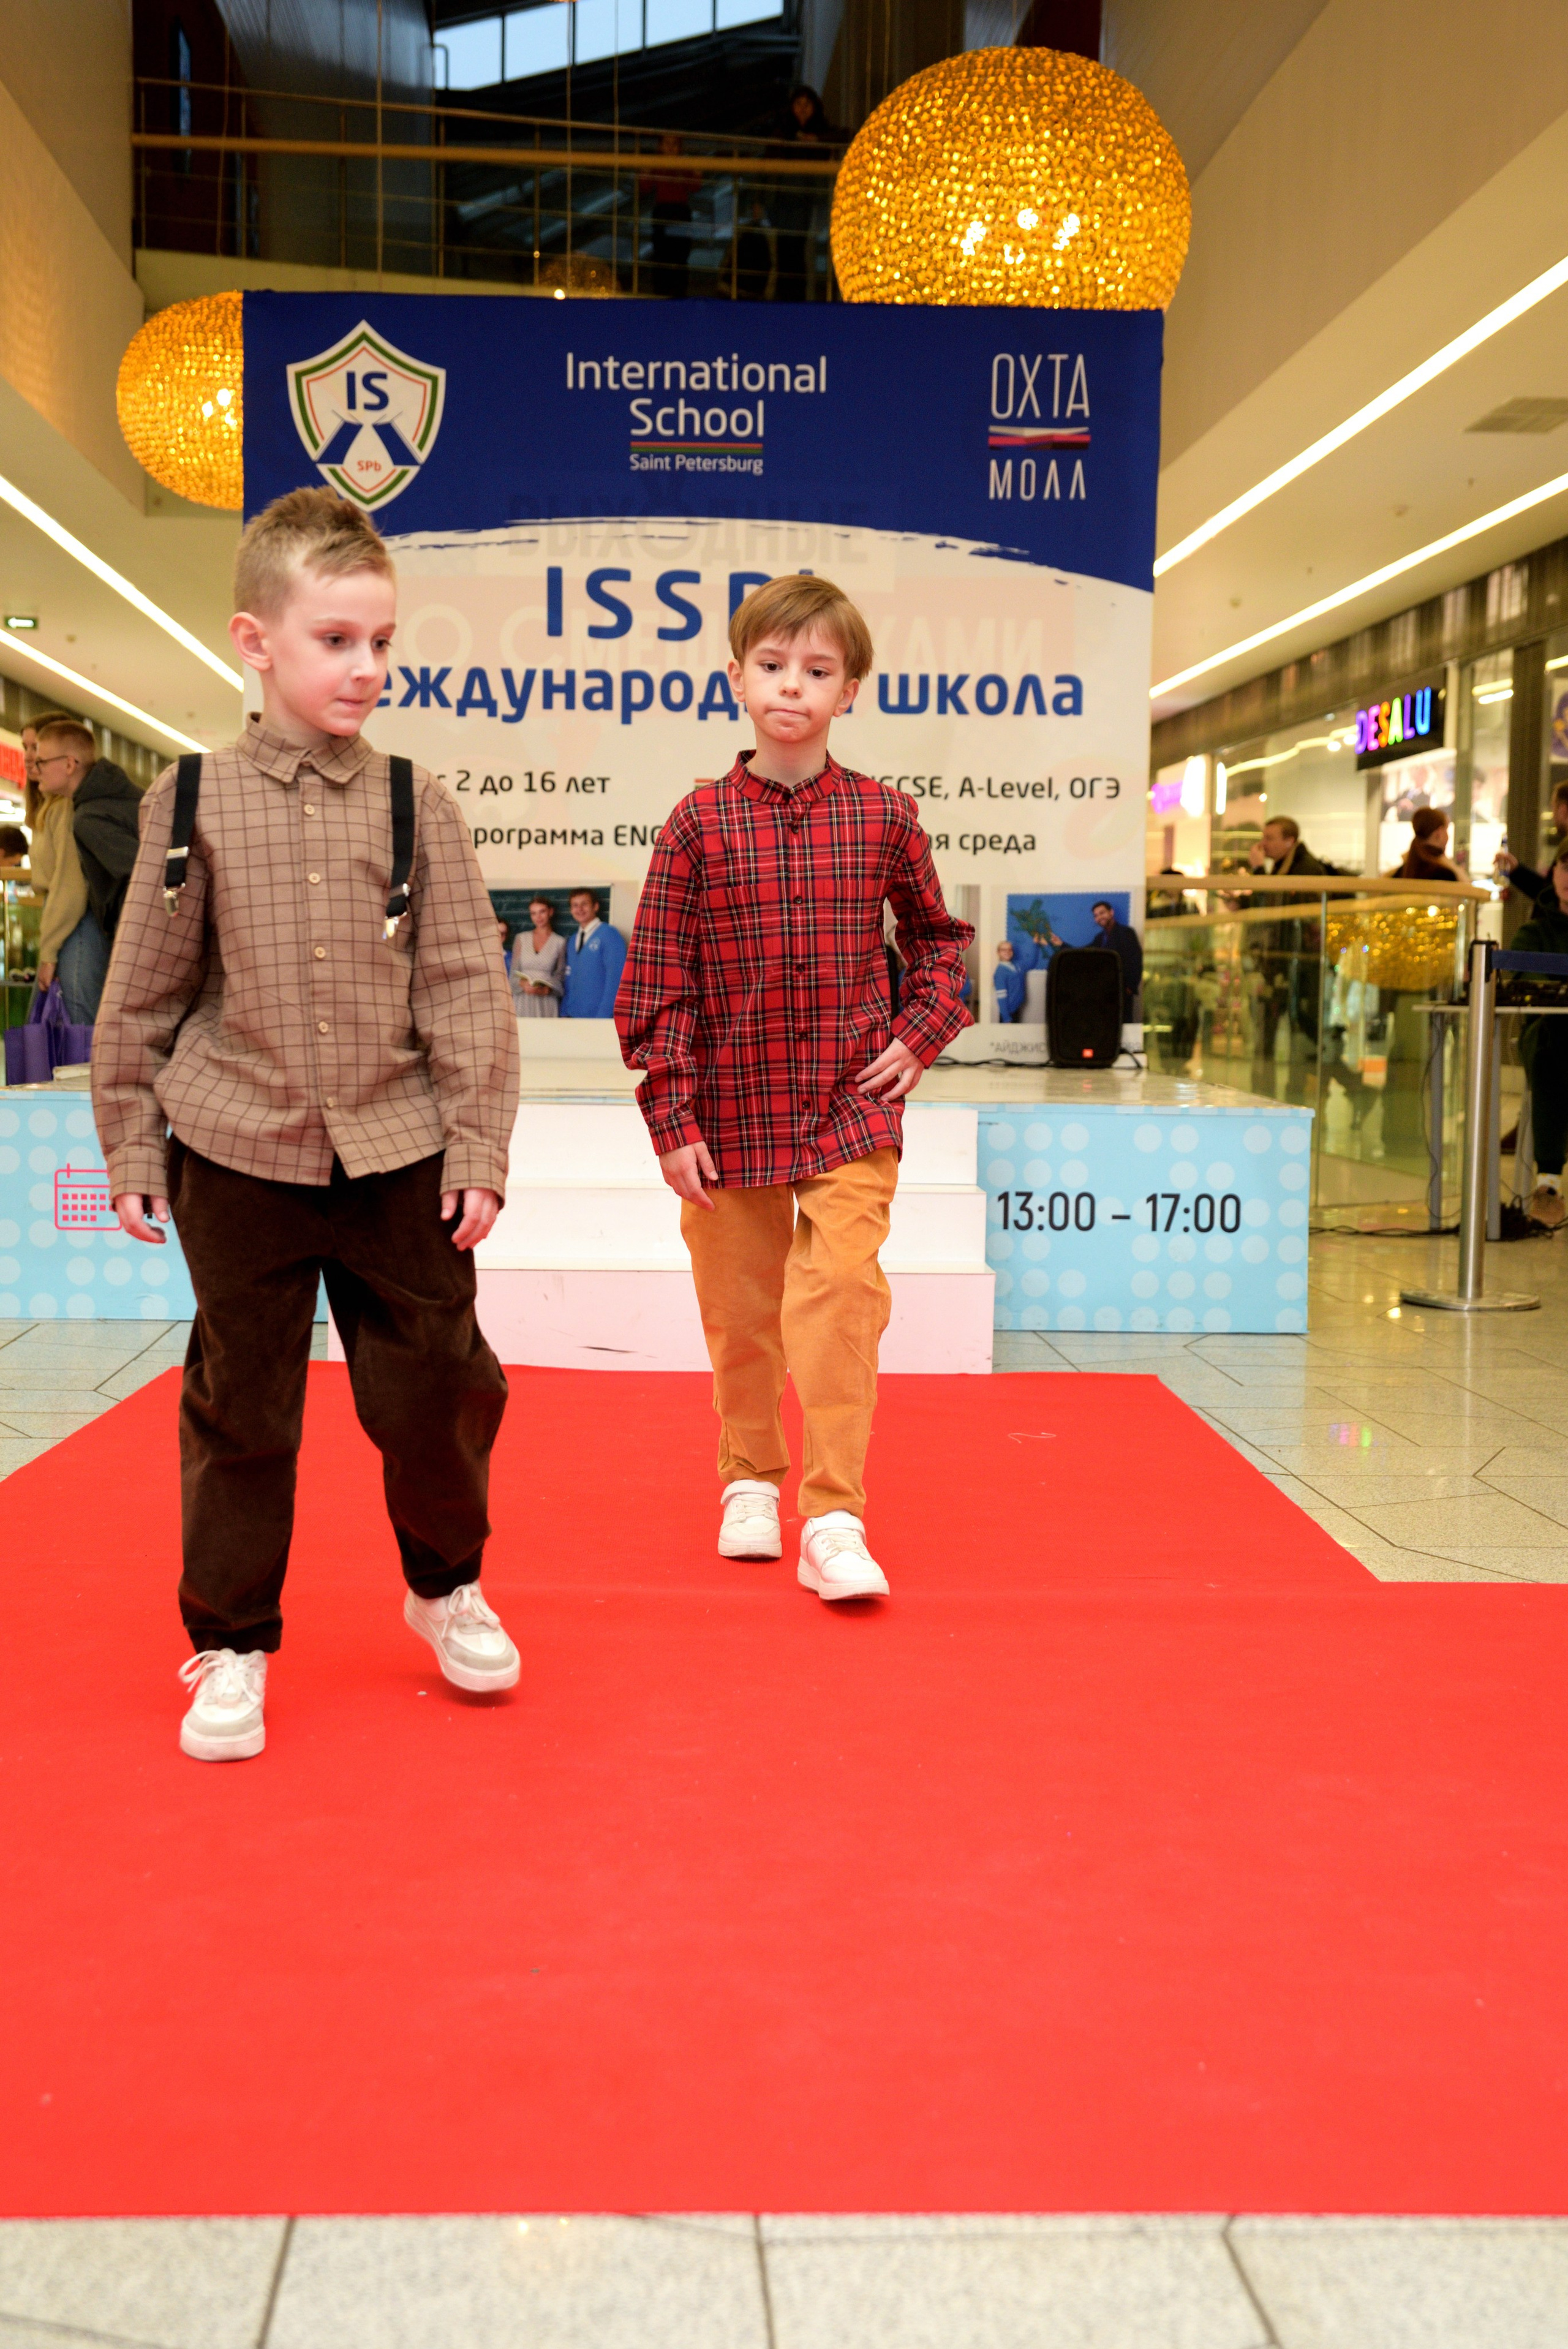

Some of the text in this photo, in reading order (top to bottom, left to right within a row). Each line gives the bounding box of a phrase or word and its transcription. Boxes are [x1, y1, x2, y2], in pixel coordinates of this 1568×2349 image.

[346, 370, 390, 411] IS
[567, 352, 827, 393] International
[990, 353, 1090, 420] ОХТА
[629, 398, 764, 437] School
[356, 459, 382, 472] SPb
[629, 453, 764, 476] Saint Petersburg
[988, 459, 1087, 501] МОЛЛ
[878, 673, 1083, 716] школа
[1354, 685, 1432, 749] DESALU
[456, 769, 611, 796] 2 до 16 лет
[959, 775, 1060, 801] A-Level,
[1069, 776, 1121, 799] ОГЭ
[468, 826, 604, 850] рограмма
[959, 833, 1036, 856] среда
[998, 1191, 1096, 1232] 13:00
[1145, 1193, 1242, 1233] 17:00
